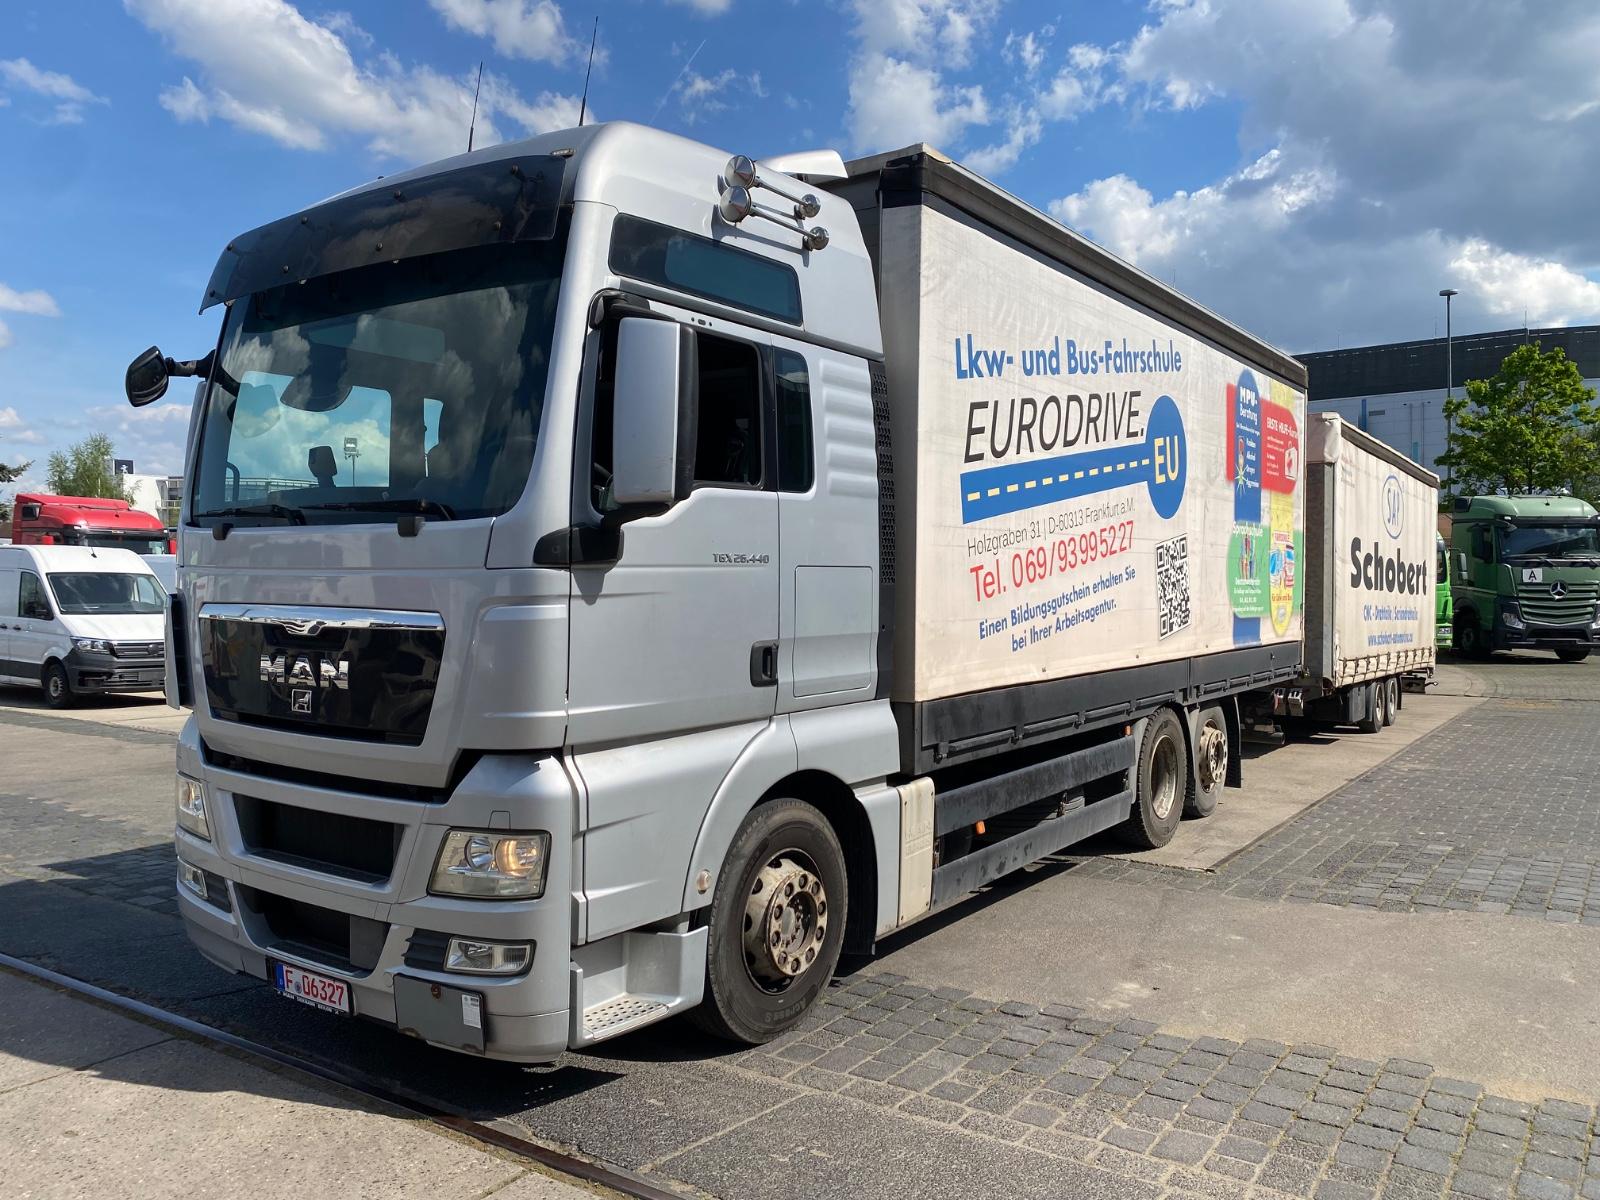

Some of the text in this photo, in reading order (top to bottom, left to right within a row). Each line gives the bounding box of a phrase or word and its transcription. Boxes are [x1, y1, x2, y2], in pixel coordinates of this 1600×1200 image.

[955, 333, 1182, 380] Lkw- und Bus-Fahrschule
[963, 390, 1145, 464] EURODRIVE.
[1153, 434, 1180, 485] EU
[967, 526, 1028, 558] Holzgraben
[1029, 520, 1042, 540] 31
[1048, 509, 1084, 535] D-60313
[1085, 502, 1119, 524] Frankfurt
[969, 558, 1007, 602] Tel.
[1350, 536, 1427, 596] Schobert
[1528, 570, 1537, 581] A
[979, 564, 1136, 640] Einen Bildungsgutschein erhalten Sie
[1011, 598, 1117, 652] bei Ihrer Arbeitsagentur.
[260, 654, 349, 690] MAN
[285, 968, 294, 992] F
[302, 975, 344, 1006] 06327
